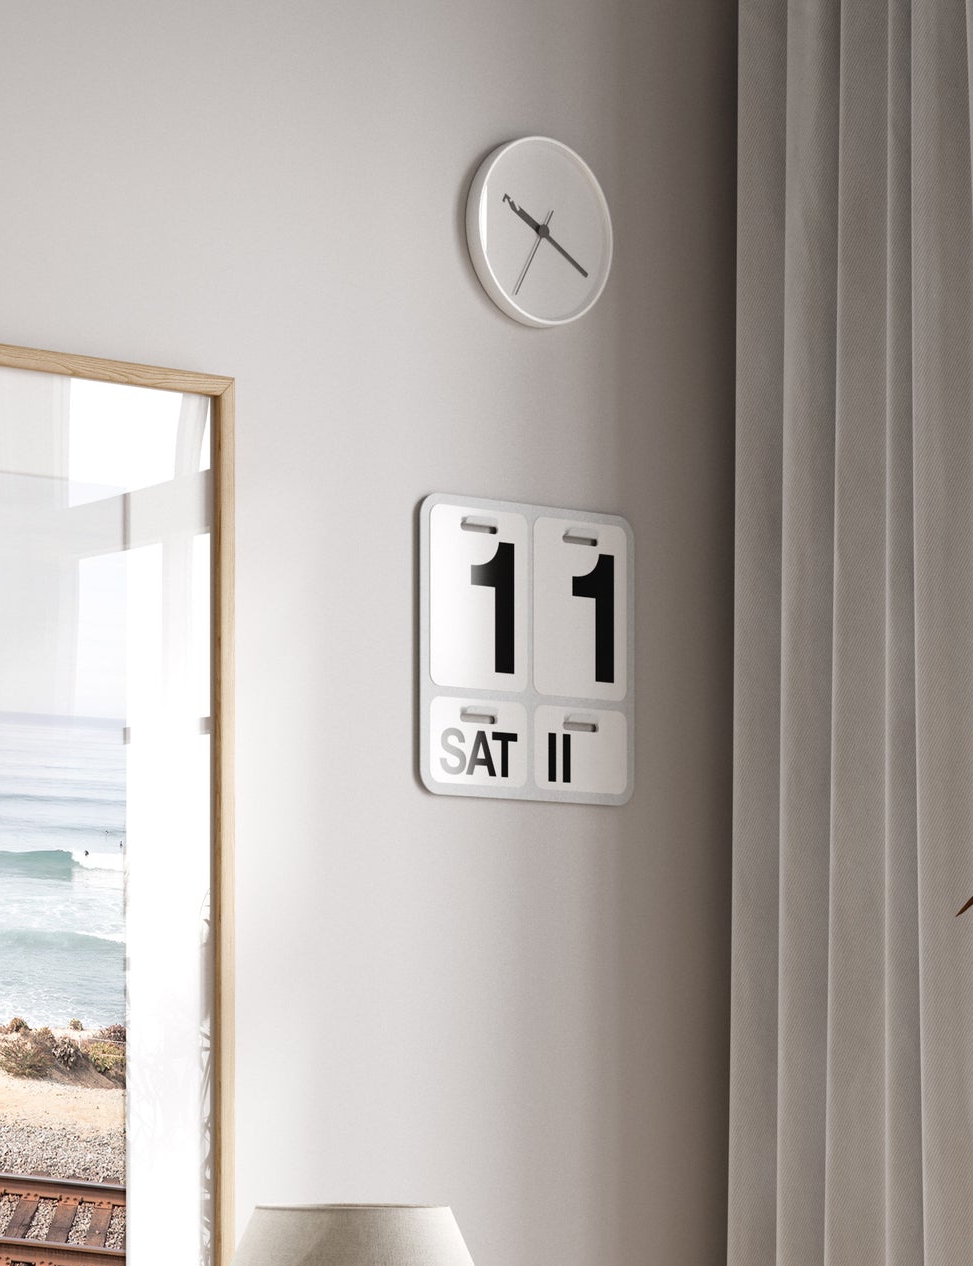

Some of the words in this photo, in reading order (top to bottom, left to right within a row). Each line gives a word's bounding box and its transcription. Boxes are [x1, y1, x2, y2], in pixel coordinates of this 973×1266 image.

[470, 541, 515, 675] 1
[572, 553, 615, 684] 1
[439, 727, 518, 778] SAT
